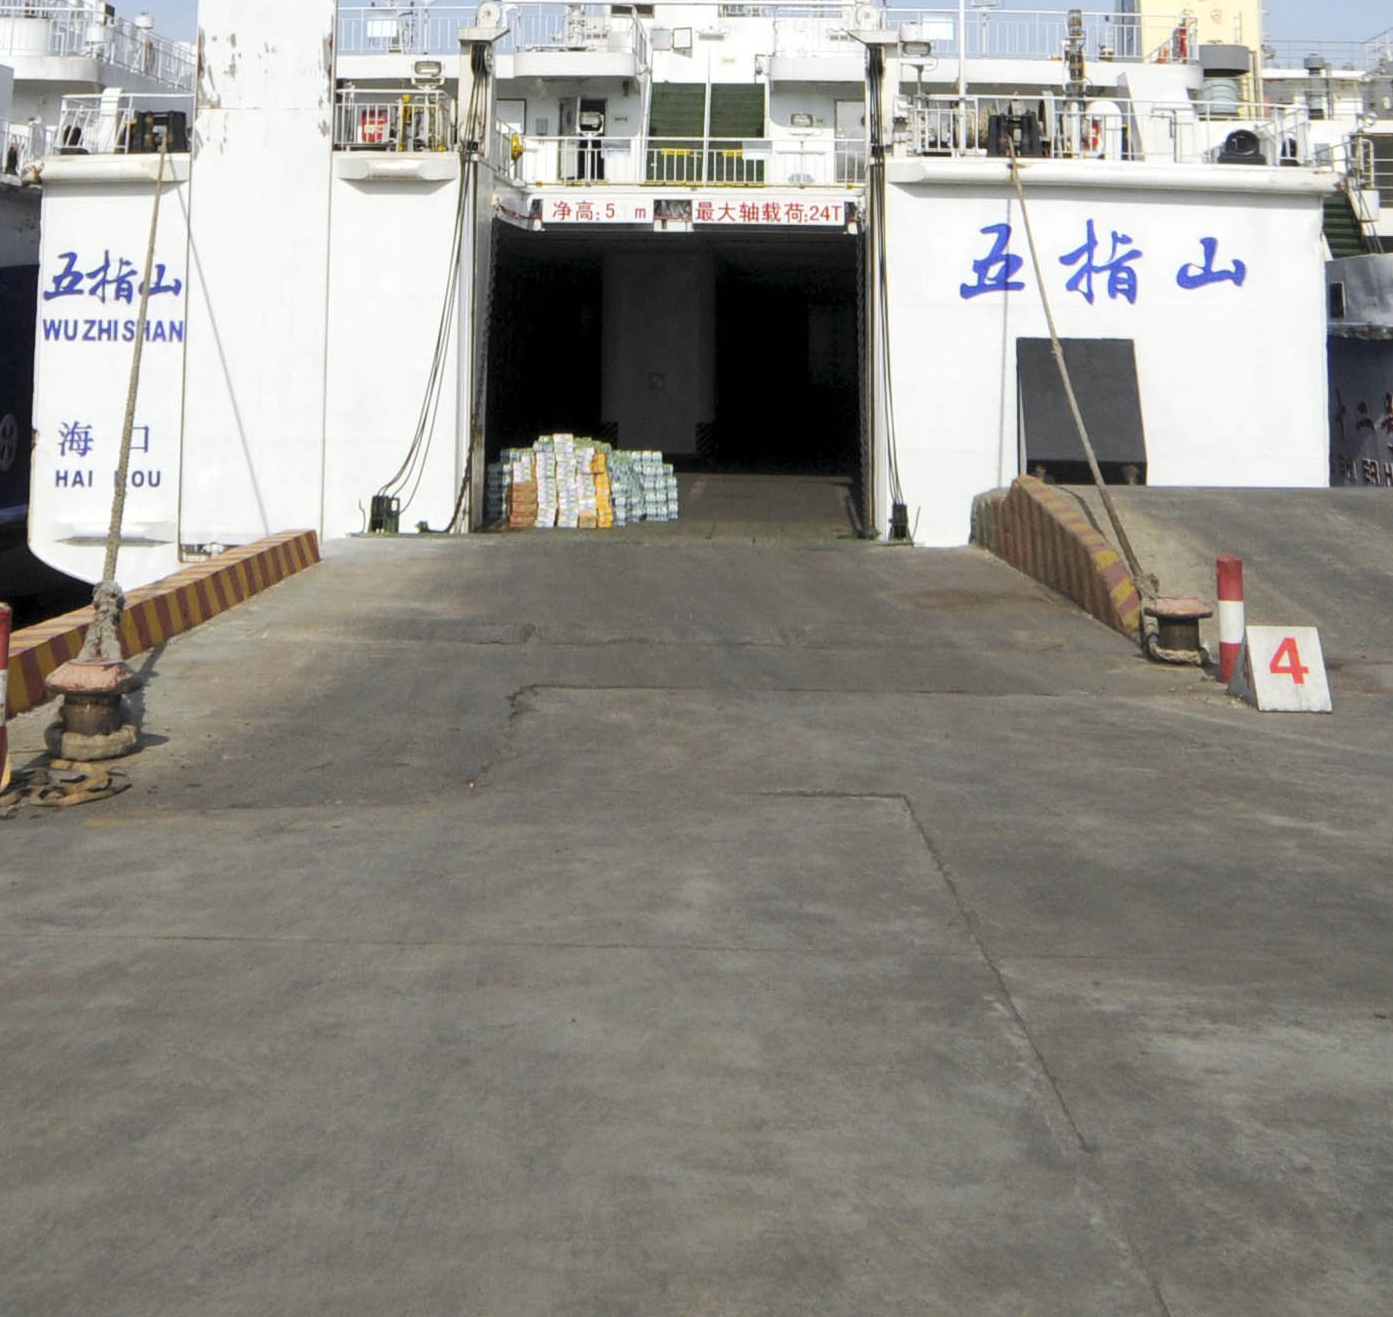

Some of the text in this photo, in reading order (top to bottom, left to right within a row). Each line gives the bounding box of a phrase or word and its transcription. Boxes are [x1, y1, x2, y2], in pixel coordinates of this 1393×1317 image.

[43, 249, 182, 304] 五指山
[959, 218, 1246, 305] 五指山
[58, 420, 149, 457] 海口
[55, 470, 161, 487] HAI OU
[1269, 637, 1310, 685] 4
